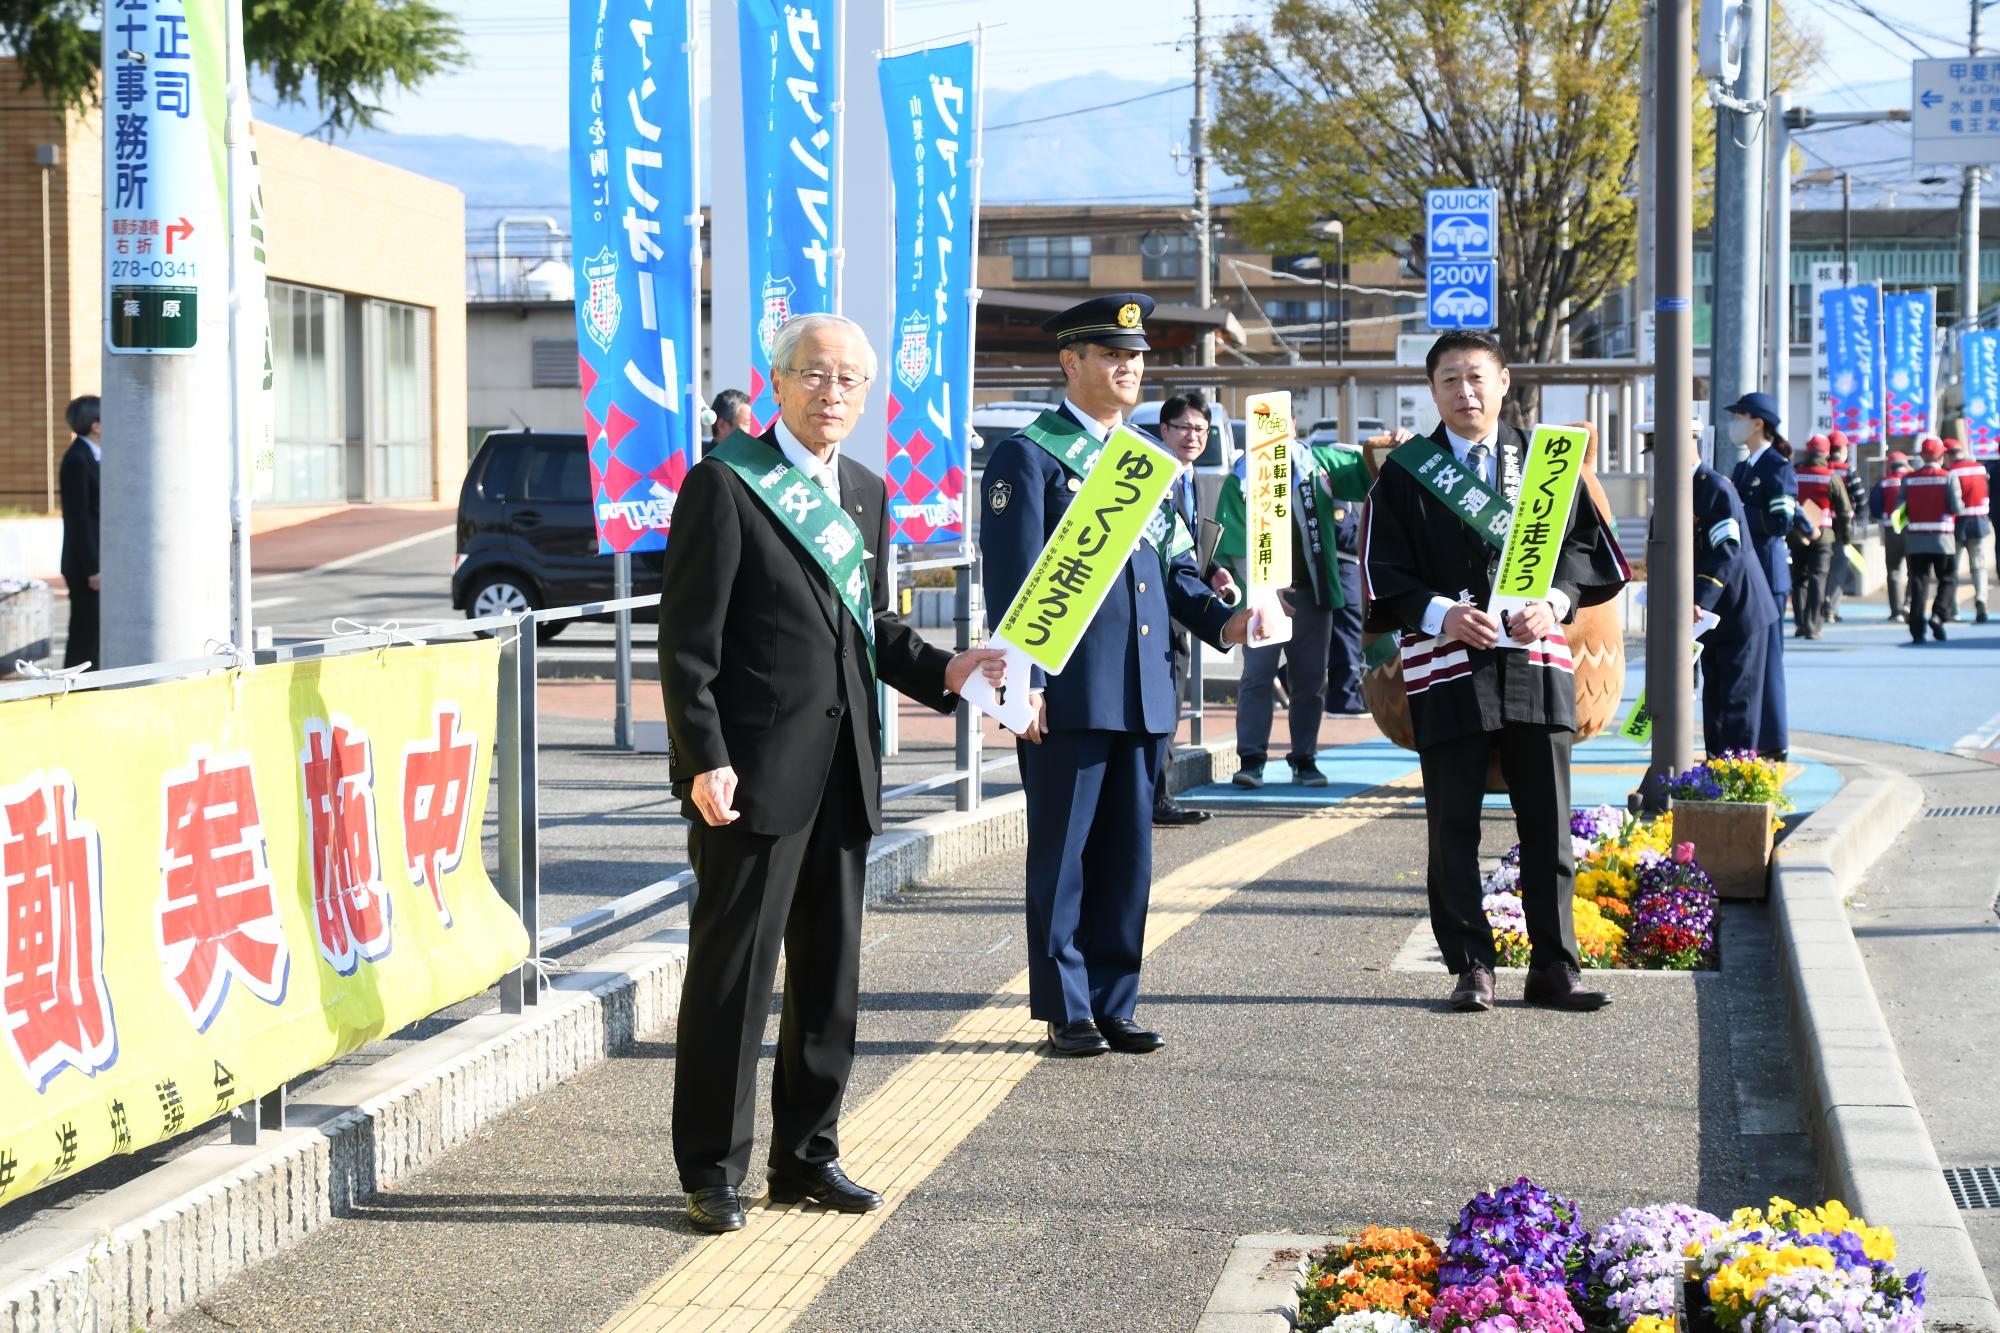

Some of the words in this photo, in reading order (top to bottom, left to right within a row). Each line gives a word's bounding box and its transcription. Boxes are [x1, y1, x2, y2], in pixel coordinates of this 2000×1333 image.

[115, 0, 148, 210] 士事務所
[155, 0, 190, 119] 正司
[1432, 194, 1489, 210] QUICK
[112, 260, 196, 278] 278-0341
[1432, 265, 1489, 285] 200V
[1273, 443, 1288, 518] 自転車も
[1514, 435, 1572, 592] ゆっくり走ろう
[1024, 449, 1154, 646] ゆっくり走ろう
